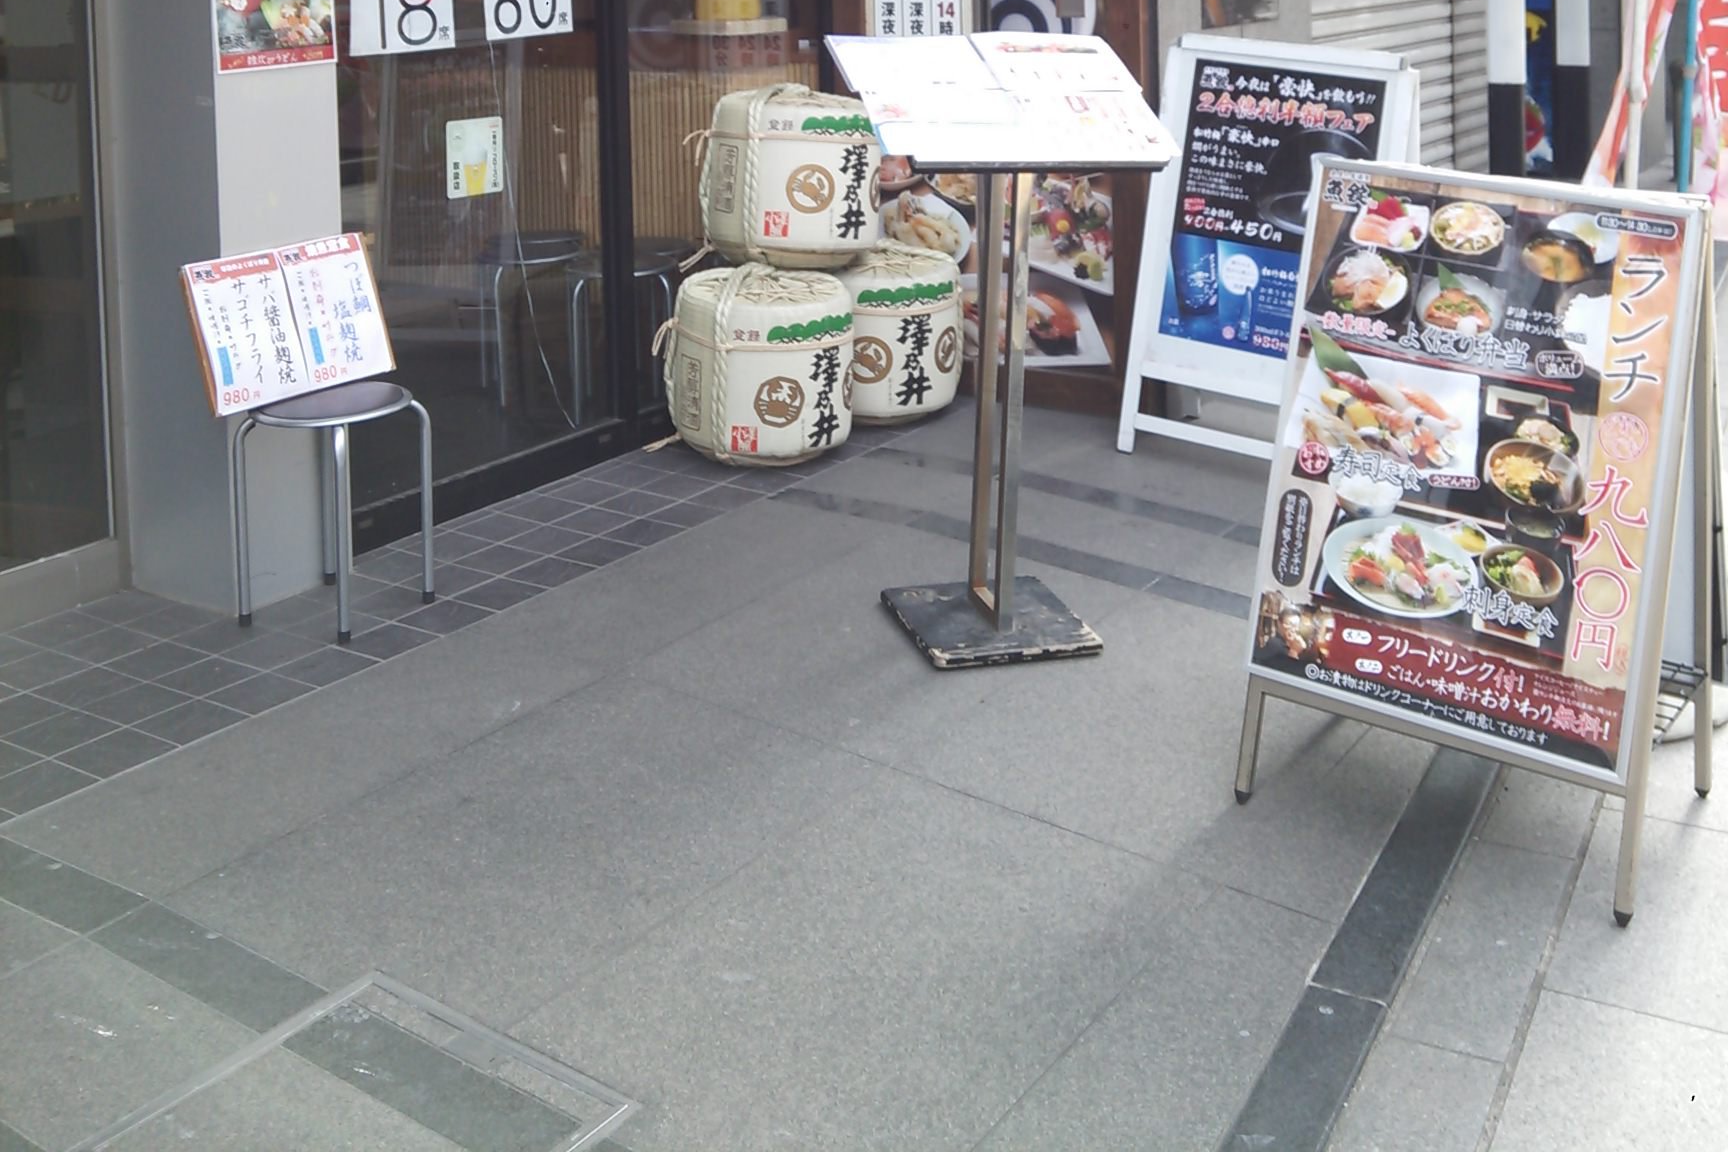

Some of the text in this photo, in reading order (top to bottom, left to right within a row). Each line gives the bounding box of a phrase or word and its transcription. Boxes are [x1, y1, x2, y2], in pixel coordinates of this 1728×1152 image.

[834, 143, 870, 240] 澤乃井
[896, 313, 932, 406] 澤乃井
[1399, 321, 1531, 373] よくばり弁当
[1600, 253, 1669, 403] ランチ
[807, 345, 841, 448] 澤乃井
[1331, 443, 1423, 492] 寿司定食
[1461, 585, 1561, 640] 刺身定食
